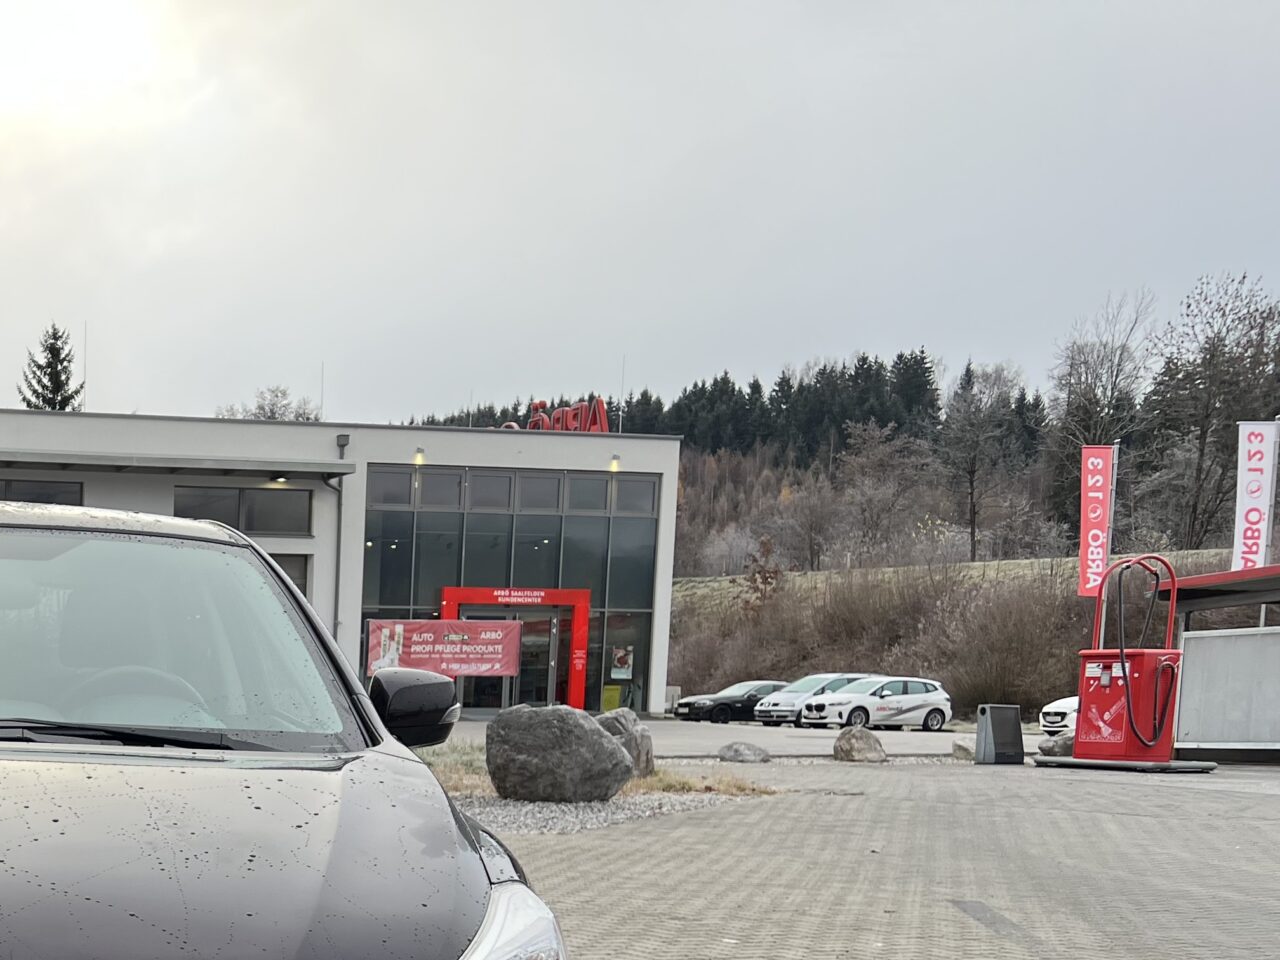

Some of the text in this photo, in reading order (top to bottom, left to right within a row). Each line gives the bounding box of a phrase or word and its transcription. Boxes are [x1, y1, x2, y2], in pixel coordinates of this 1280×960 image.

[411, 633, 434, 642] AUTO
[411, 644, 503, 653] PROFI PFLEGE PRODUKTE
